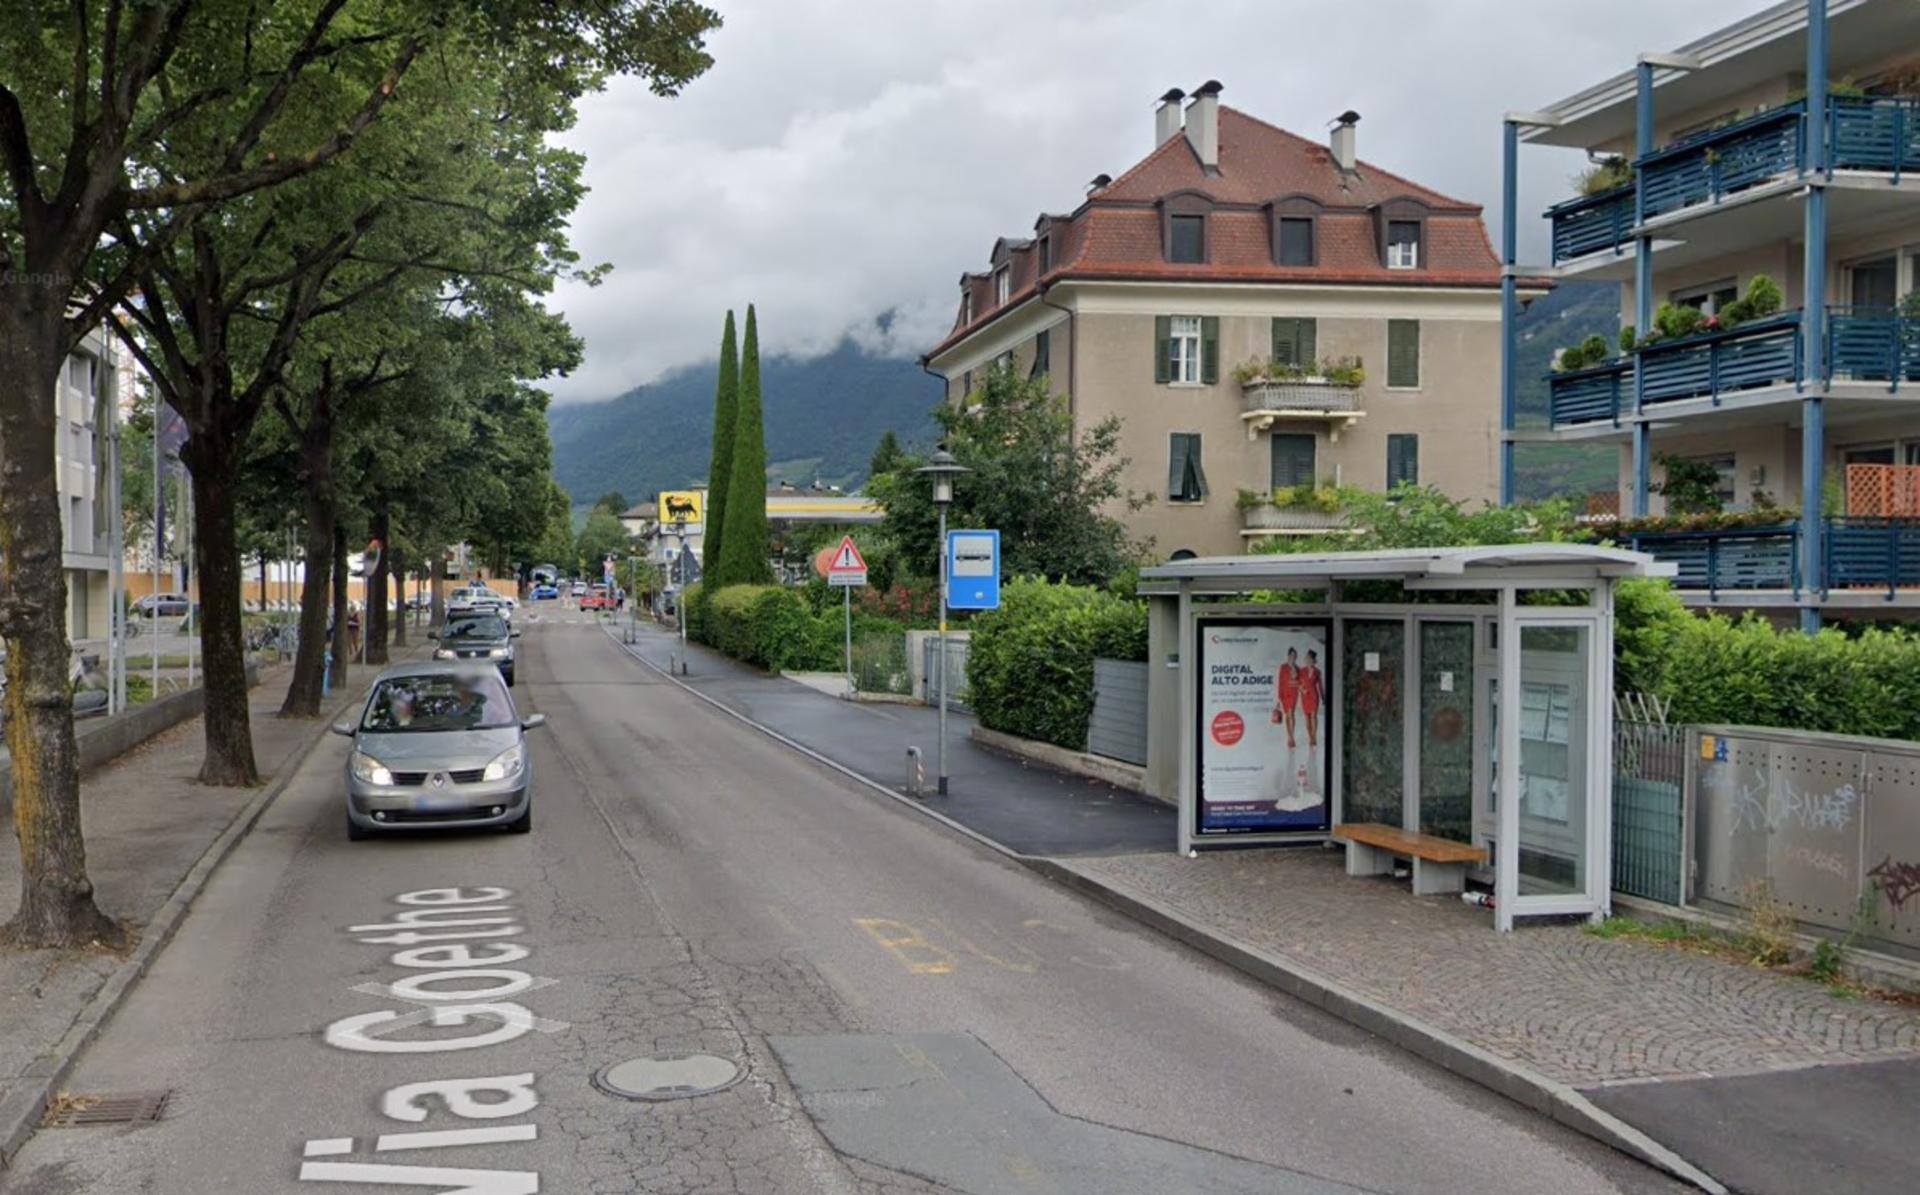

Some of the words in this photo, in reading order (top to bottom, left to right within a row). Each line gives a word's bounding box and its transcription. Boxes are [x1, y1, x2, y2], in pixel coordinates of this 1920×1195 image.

[1211, 665, 1253, 674] DIGITAL
[1211, 675, 1240, 685] ALTO
[1241, 676, 1272, 684] ADIGE
